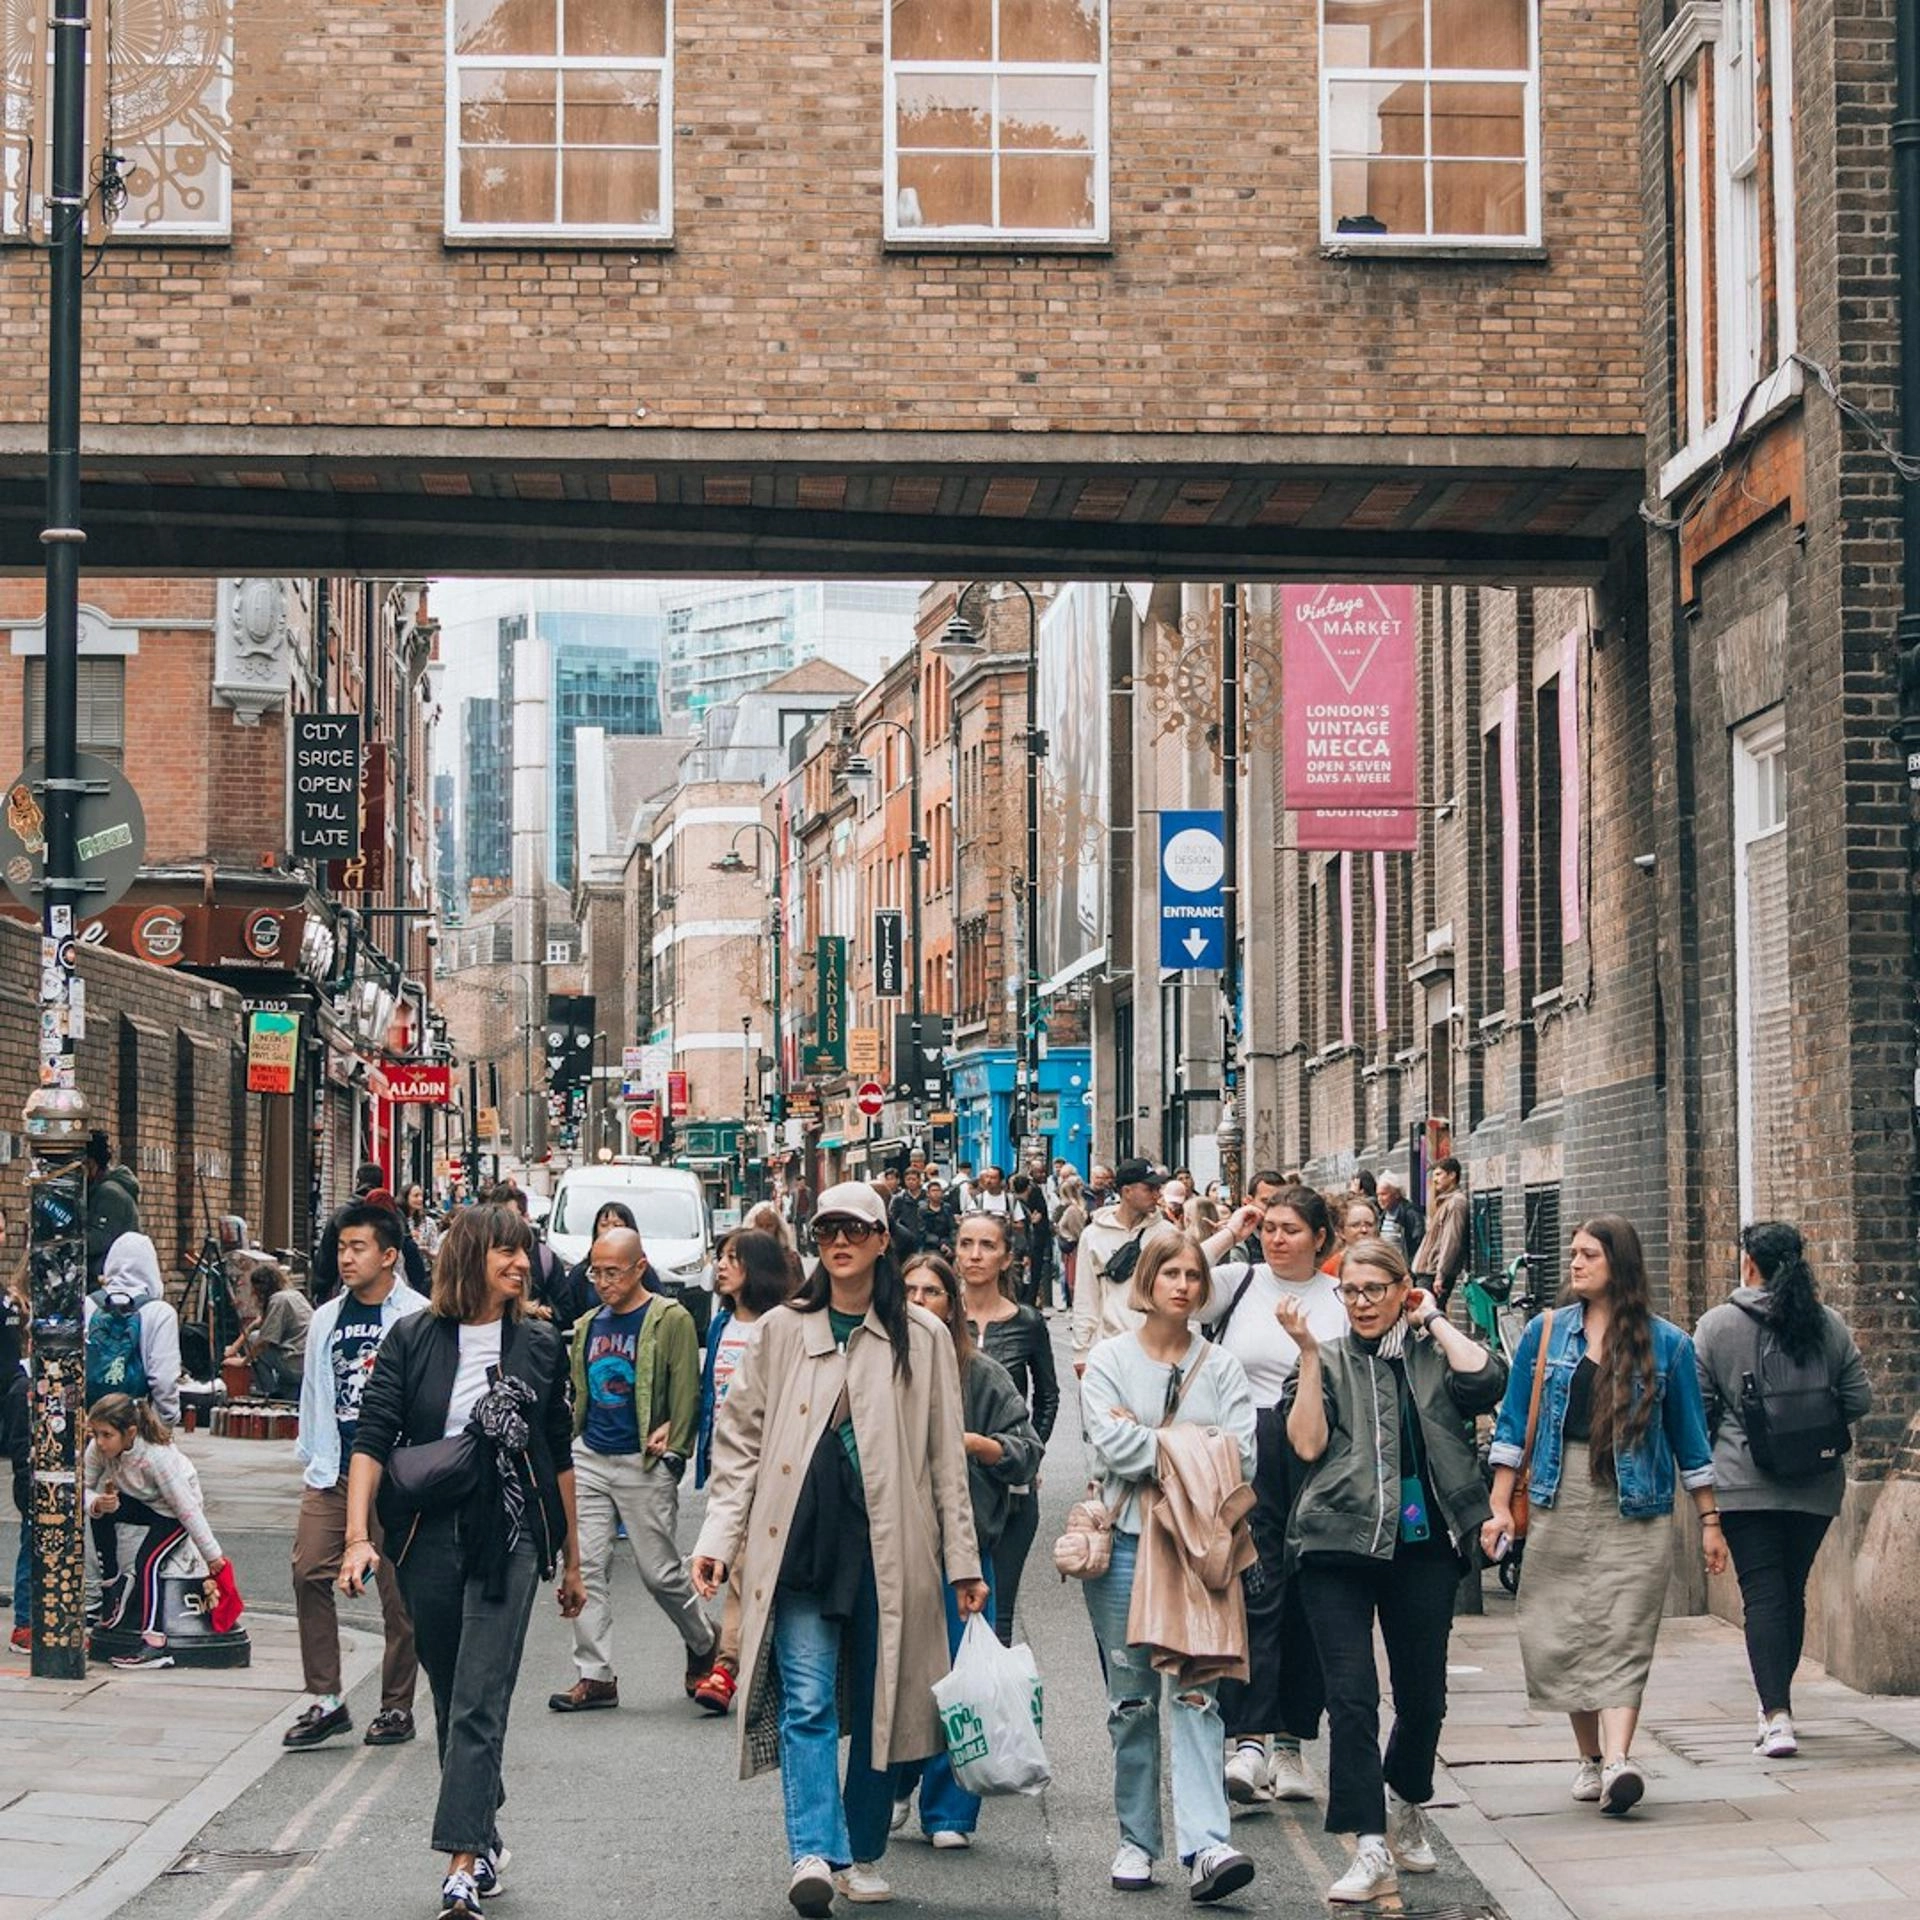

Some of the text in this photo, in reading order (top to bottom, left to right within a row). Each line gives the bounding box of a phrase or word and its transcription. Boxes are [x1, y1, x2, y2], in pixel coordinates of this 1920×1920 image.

[1296, 597, 1364, 621] Vintage
[1323, 620, 1402, 635] MARKET
[1306, 705, 1390, 717] LONDON'S
[1307, 721, 1390, 735] VINTAGE
[1307, 739, 1390, 757] MECCA
[1306, 760, 1392, 772] OPEN SEVEN
[299, 776, 352, 793] OPEN
[1306, 773, 1392, 784] DAYS A WEEK
[302, 830, 349, 846] LATE
[1175, 855, 1212, 864] DESIGN
[1163, 906, 1225, 918] ENTRANCE
[882, 917, 894, 990] VILLAGE
[827, 940, 839, 1043] STANDARD
[390, 1082, 446, 1095] ALADIN
